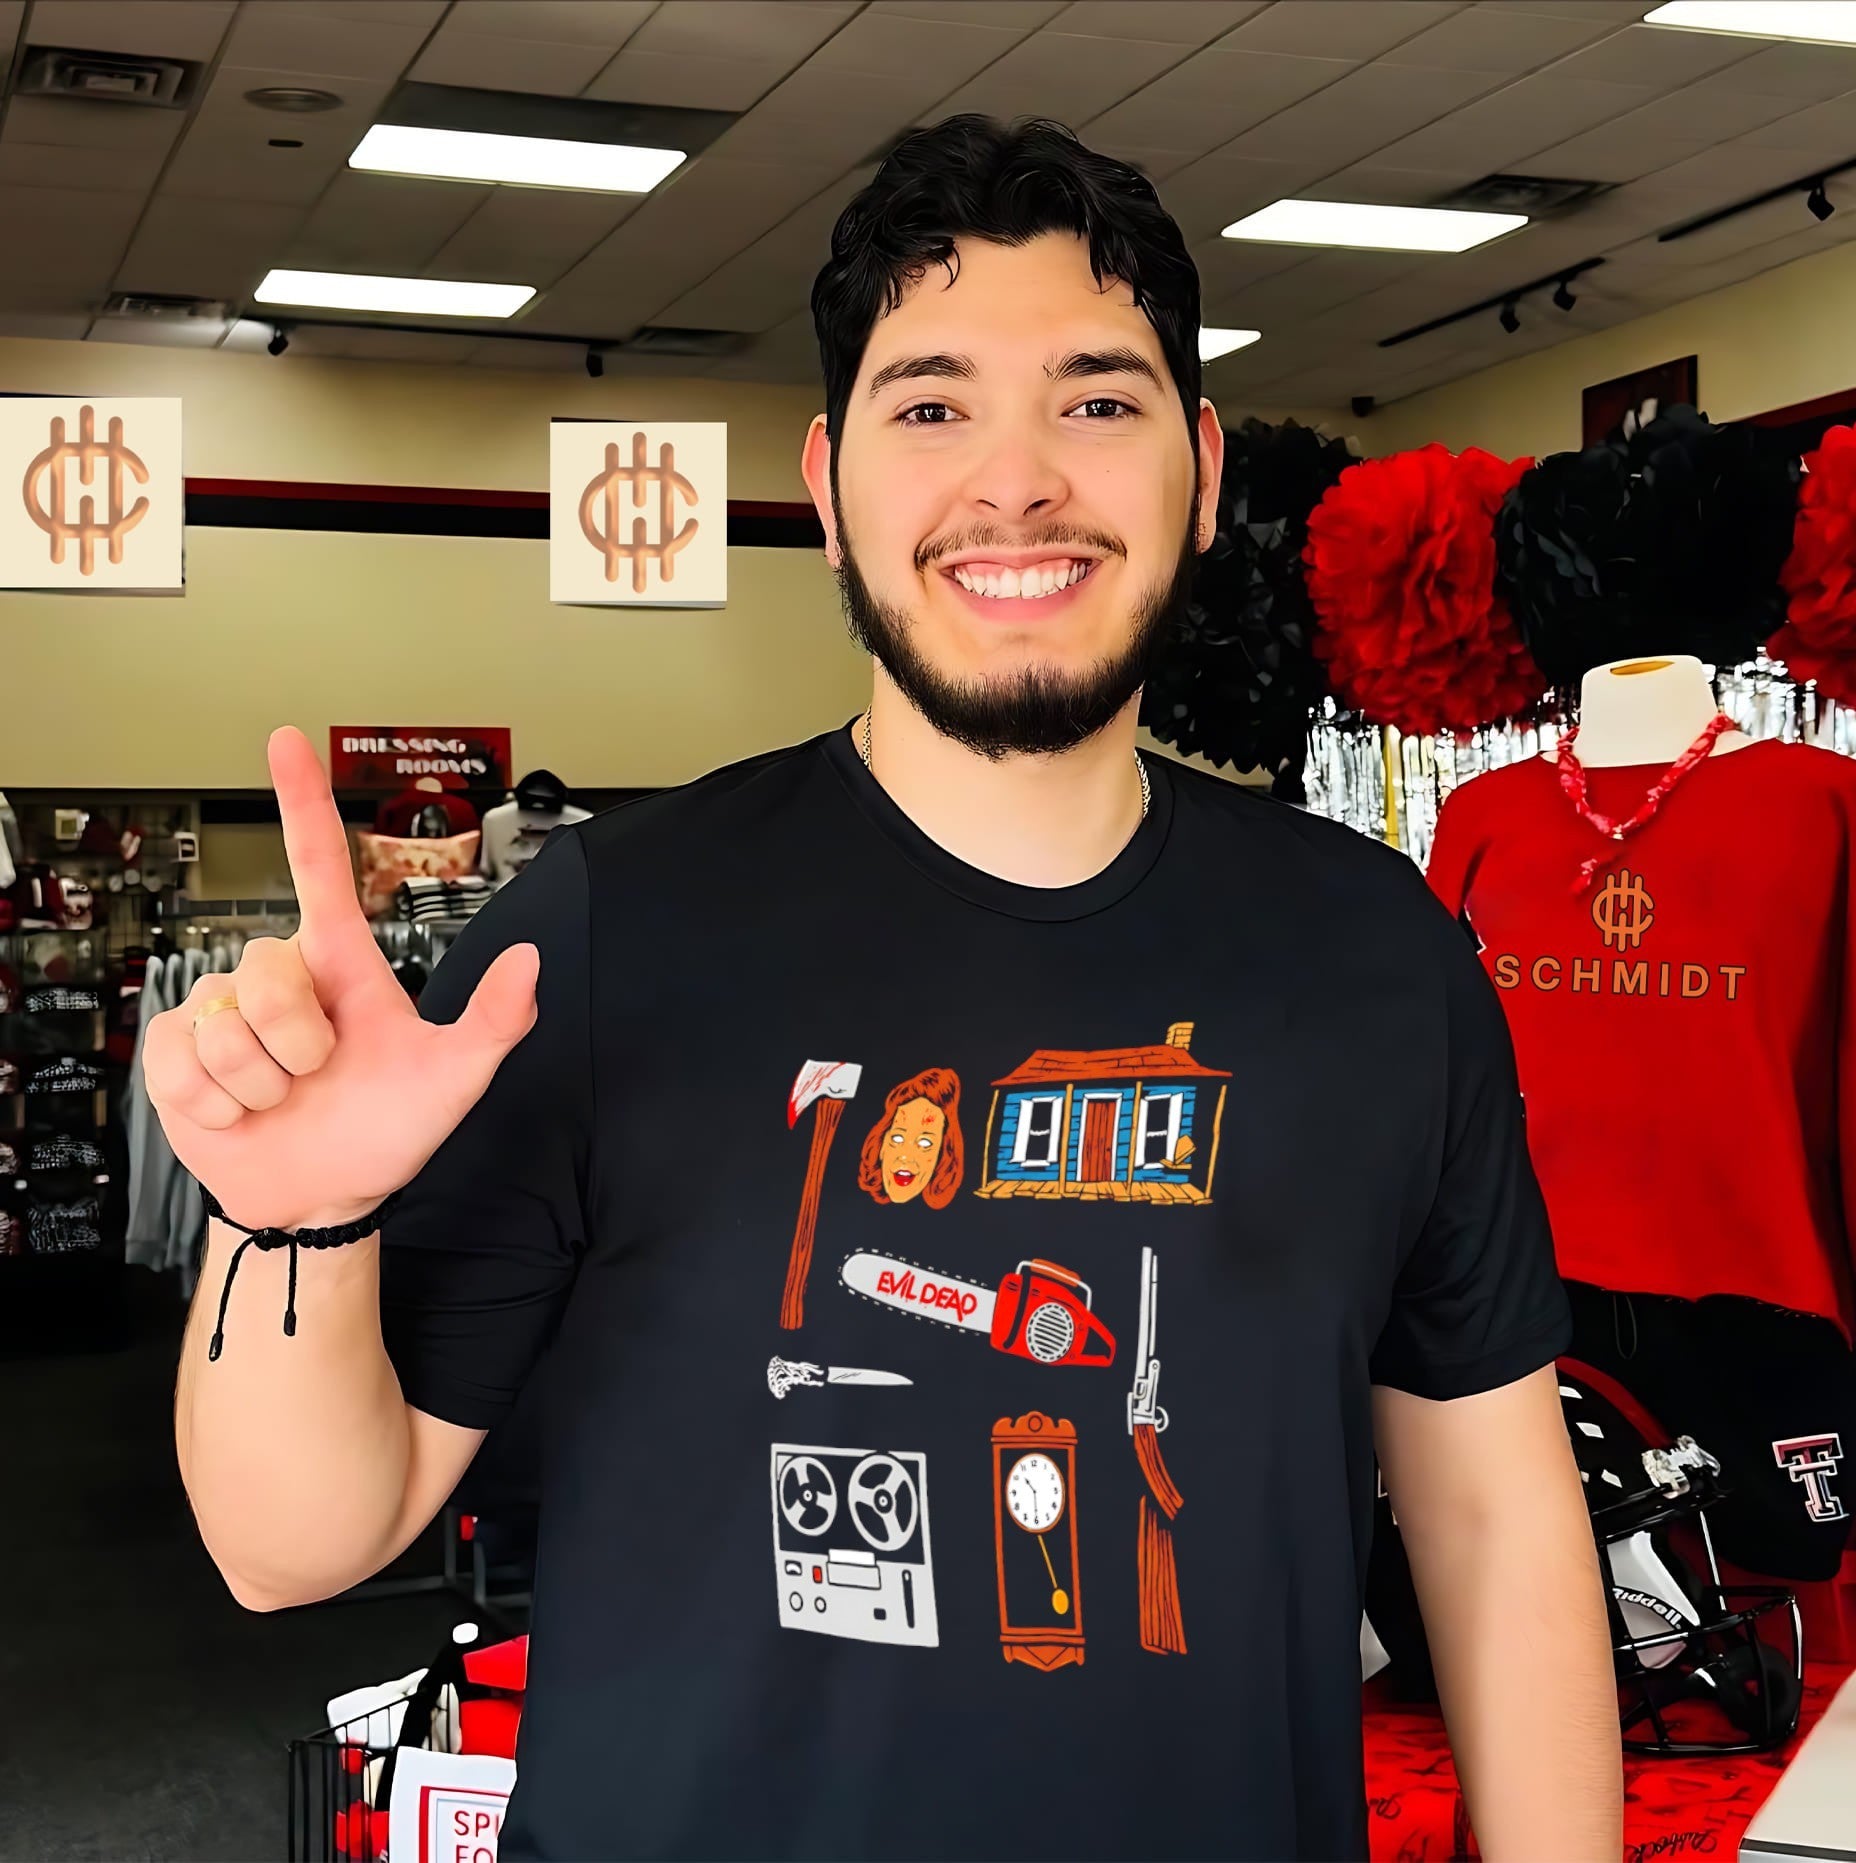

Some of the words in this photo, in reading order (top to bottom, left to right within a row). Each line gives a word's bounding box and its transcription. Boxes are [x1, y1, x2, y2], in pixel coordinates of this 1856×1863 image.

[1494, 953, 1747, 1000] SCHMIDT
[877, 1270, 917, 1302] EVIL
[919, 1282, 978, 1323] DEAD
